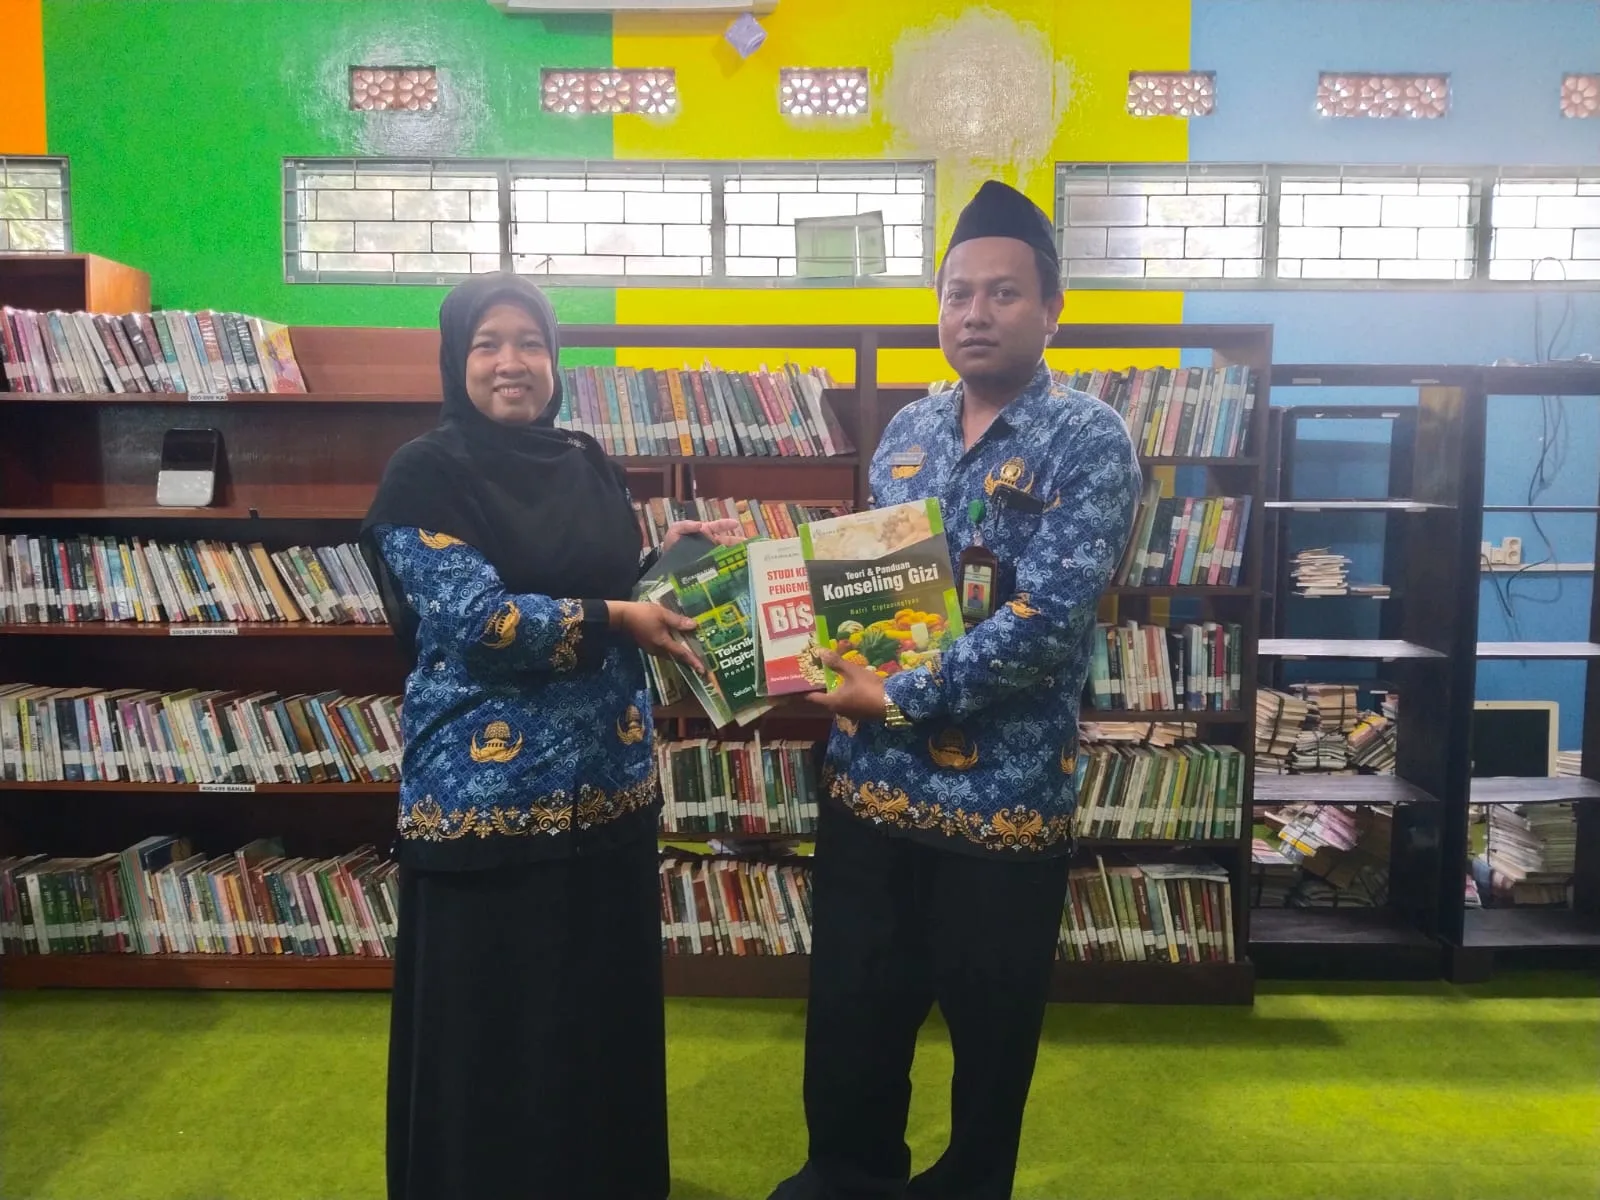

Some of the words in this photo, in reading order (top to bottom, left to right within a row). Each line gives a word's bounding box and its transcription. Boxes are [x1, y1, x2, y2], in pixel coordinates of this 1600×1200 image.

[767, 568, 794, 581] STUDI
[845, 570, 865, 581] Teori
[867, 567, 874, 577] &
[875, 561, 910, 575] Panduan
[822, 574, 904, 601] Konseling
[908, 563, 939, 585] Gizi
